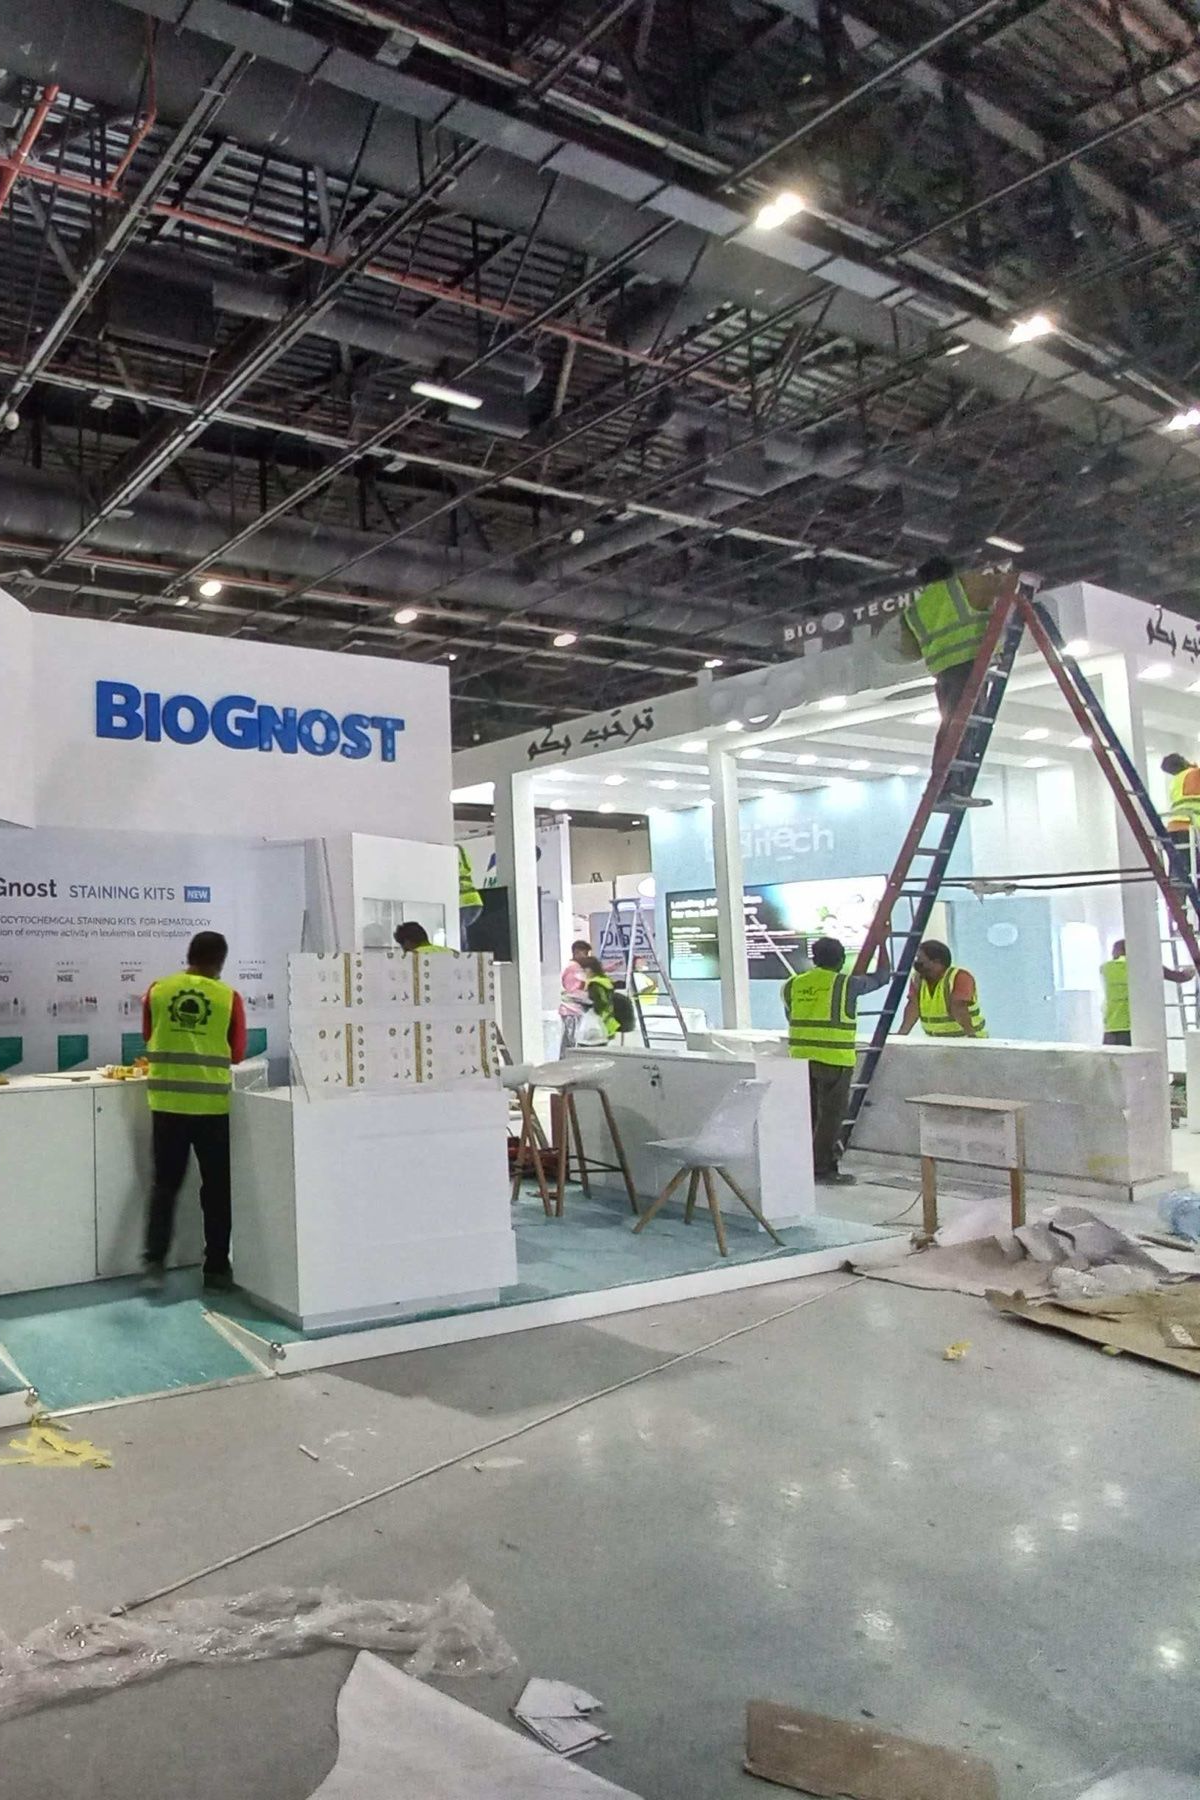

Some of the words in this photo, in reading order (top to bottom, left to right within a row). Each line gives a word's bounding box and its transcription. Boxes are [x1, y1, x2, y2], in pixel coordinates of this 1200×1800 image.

[783, 622, 817, 642] BIO
[69, 885, 140, 900] STAINING
[143, 887, 175, 900] KITS
[186, 889, 208, 900] NEW
[77, 916, 117, 926] STAINING
[15, 927, 24, 936] of
[25, 929, 59, 939] enzyme
[60, 929, 89, 939] activity
[56, 974, 74, 983] NSE
[120, 973, 136, 982] SPE
